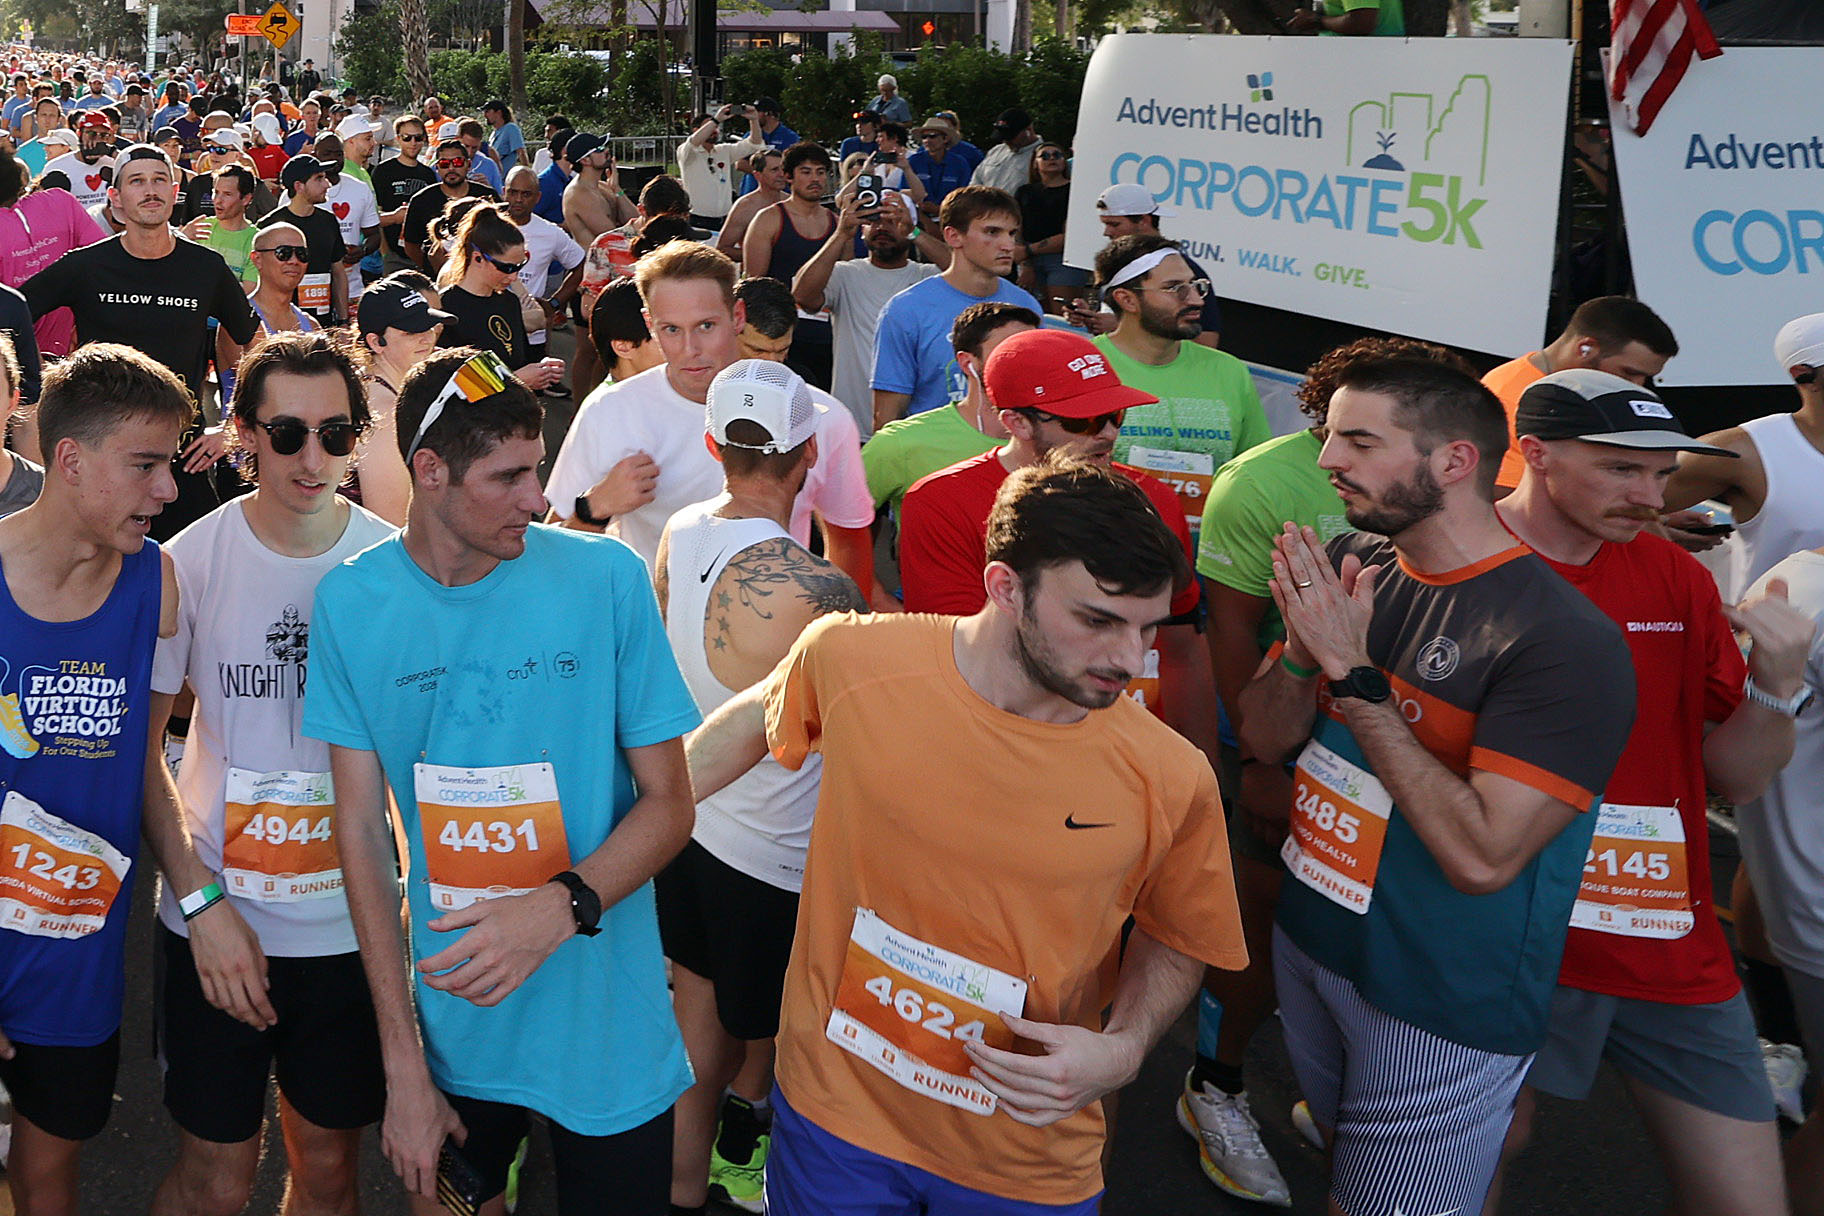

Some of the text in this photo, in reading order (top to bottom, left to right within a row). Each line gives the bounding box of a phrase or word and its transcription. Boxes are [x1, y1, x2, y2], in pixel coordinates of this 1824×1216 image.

[1238, 248, 1302, 276] WALK.
[1314, 263, 1370, 290] GIVE.
[98, 293, 198, 310] YELLOW SHOES
[1178, 428, 1232, 441] WHOLE
[59, 660, 106, 676] TEAM
[30, 675, 127, 698] FLORIDA
[24, 695, 122, 718] VIRTUAL
[32, 715, 122, 738] SCHOOL
[42, 746, 59, 757] For
[54, 735, 111, 749] Stepping Up
[1295, 783, 1361, 844] 2485
[242, 813, 332, 846] 4944
[439, 818, 539, 854] 4431
[10, 842, 103, 891] 1243
[1301, 863, 1366, 906] RUNNER
[864, 975, 985, 1045] 4624
[912, 1070, 992, 1108] RUNNER
